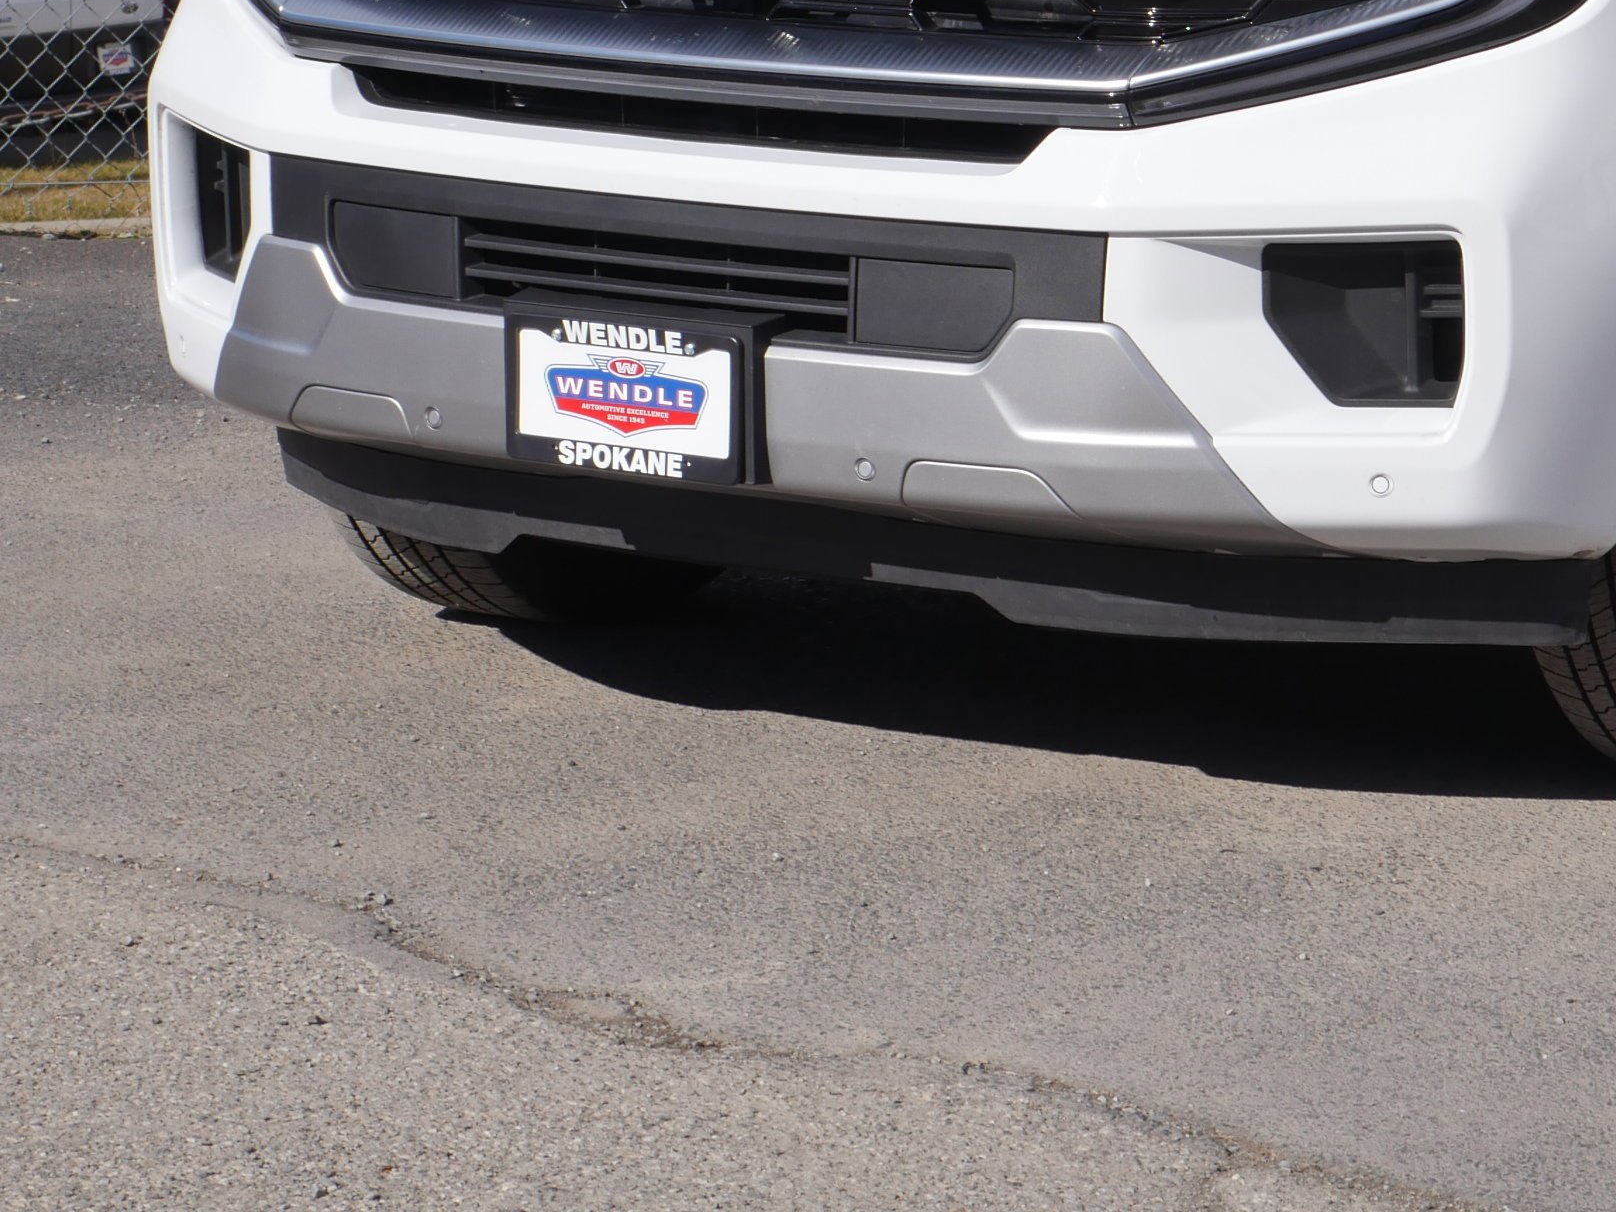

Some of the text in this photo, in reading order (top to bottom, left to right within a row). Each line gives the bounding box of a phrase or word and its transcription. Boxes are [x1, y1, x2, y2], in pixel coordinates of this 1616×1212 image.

[561, 319, 684, 355] WENDLE
[555, 376, 694, 408] WENDLE
[581, 402, 670, 419] AUTOMOTIVE EXCELLENCE
[607, 413, 628, 423] SINCE
[557, 439, 683, 478] SPOKANE
